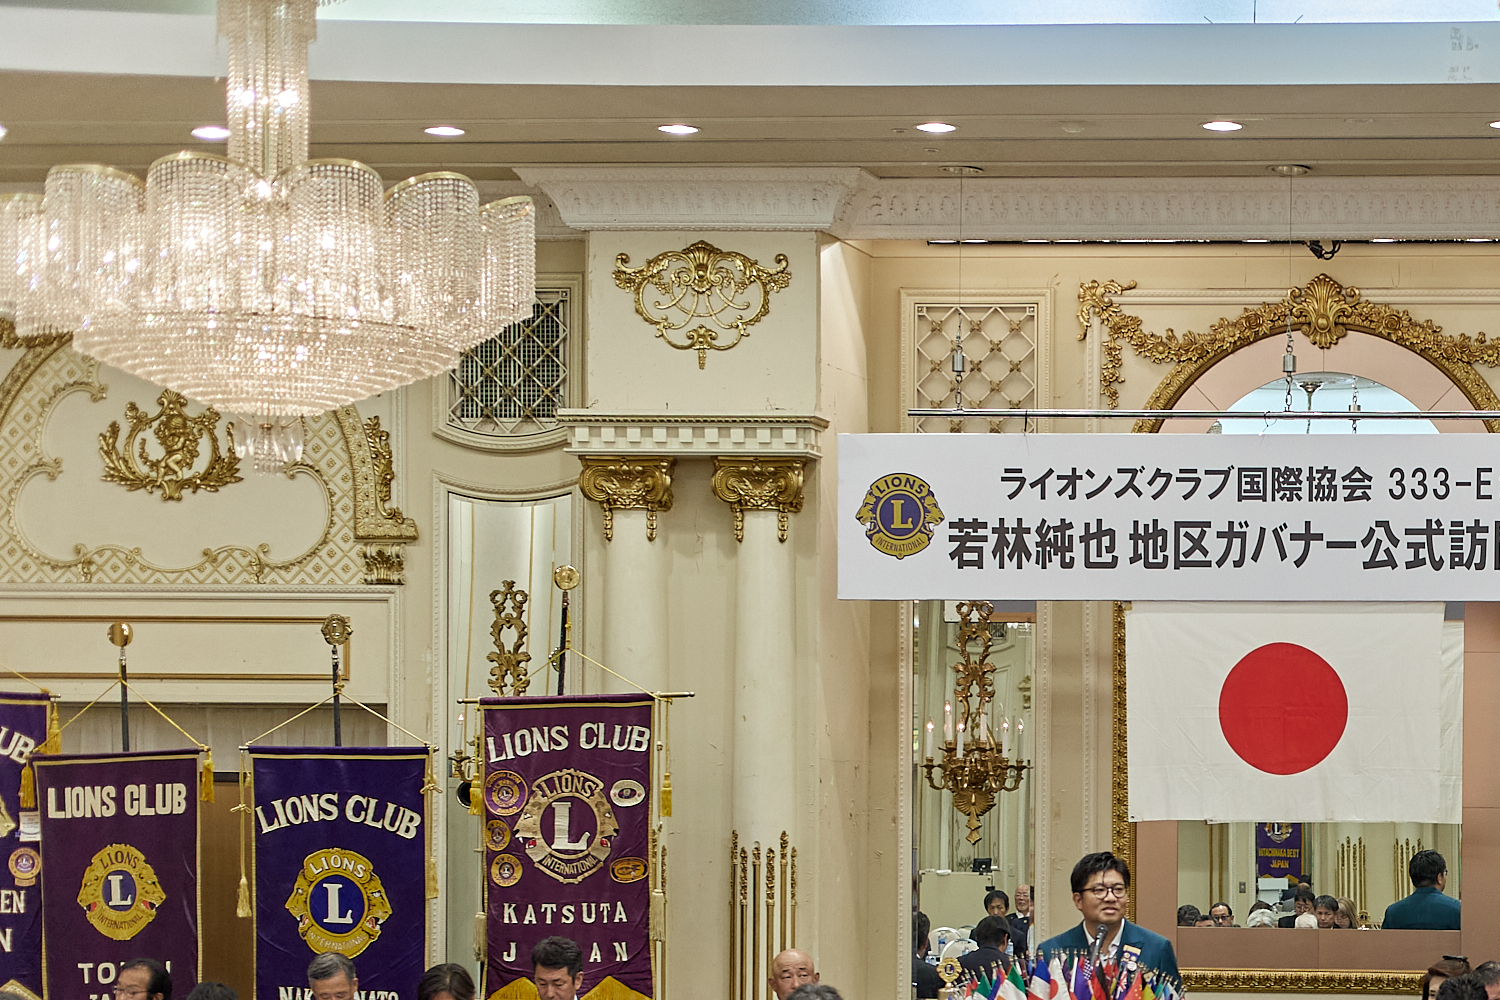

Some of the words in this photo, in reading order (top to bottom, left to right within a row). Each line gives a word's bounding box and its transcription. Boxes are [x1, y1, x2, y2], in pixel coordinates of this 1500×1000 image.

[875, 477, 926, 495] LIONS
[1000, 466, 1374, 502] ライオンズクラブ国際協会
[875, 537, 926, 552] INTERNATIONAL
[0, 726, 35, 764] UB
[486, 725, 570, 763] LIONS
[579, 722, 651, 752] CLUB
[541, 774, 597, 798] LIONS
[48, 785, 117, 819] LIONS
[124, 783, 187, 816] CLUB
[255, 792, 339, 835] LIONS
[345, 794, 423, 840] CLUB
[551, 801, 591, 851] L
[99, 850, 140, 869] LIONS
[308, 854, 366, 879] LIONS
[542, 853, 599, 876] INTERNATIONAL
[0, 890, 26, 914] EN
[322, 883, 354, 924] L
[502, 900, 628, 925] KATSUTA
[97, 913, 144, 931] INTERNATIONAL
[307, 929, 369, 951] INTERNATIONAL
[502, 941, 628, 963] JAN
